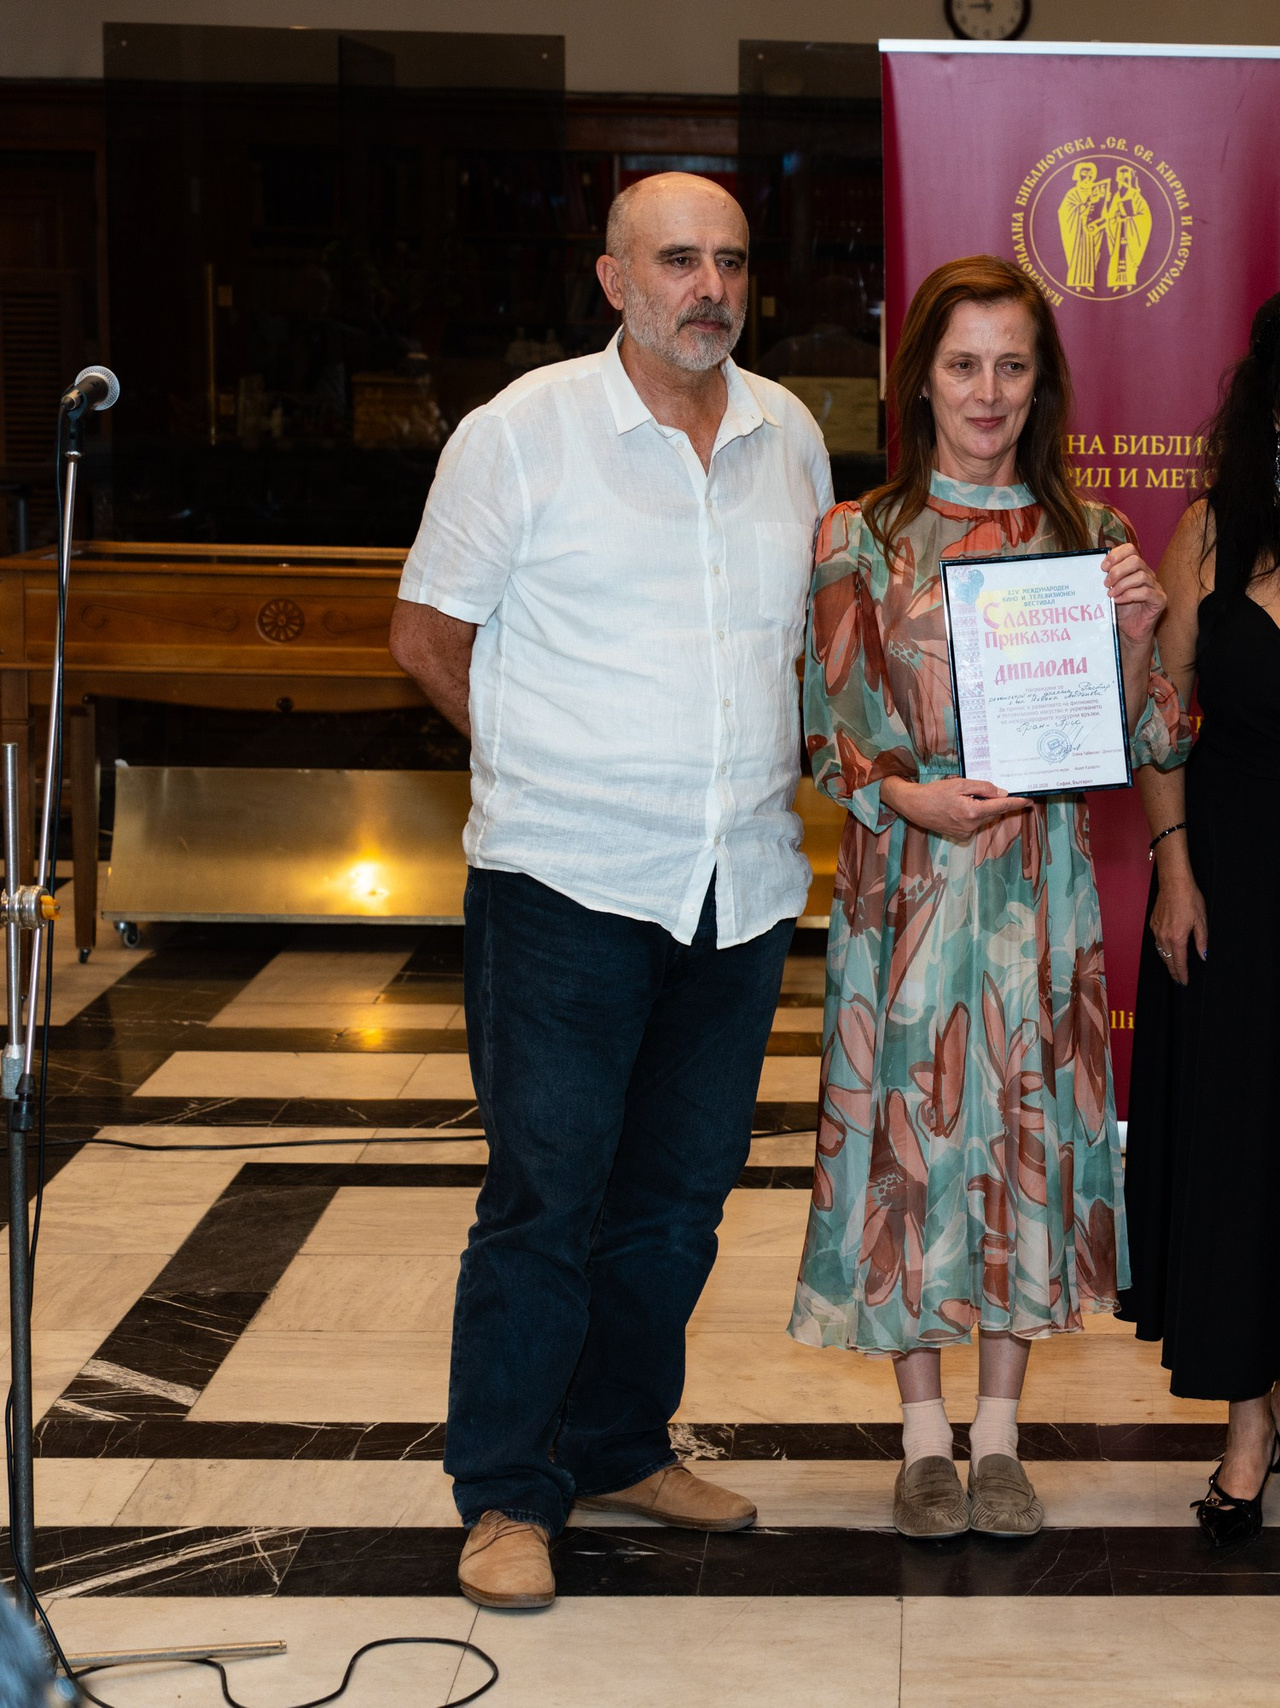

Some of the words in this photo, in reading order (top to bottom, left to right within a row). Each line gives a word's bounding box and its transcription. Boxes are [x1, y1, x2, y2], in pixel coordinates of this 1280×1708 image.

[1015, 136, 1096, 207] БИБЛИОТЕКА
[1134, 144, 1153, 164] СВ.
[1156, 160, 1190, 210] КИРИЛ
[1180, 215, 1192, 226] И
[1067, 434, 1106, 455] НА
[1112, 434, 1204, 456] БИБЛИ
[1067, 468, 1112, 488] ИЛ
[1118, 468, 1139, 488] И
[1022, 585, 1070, 594] МЕЖДУНАРОДЕН
[1030, 590, 1076, 600] ТЕЛЕВИЗИОНЕН
[1024, 599, 1055, 607] ФЕСТИВАЛ
